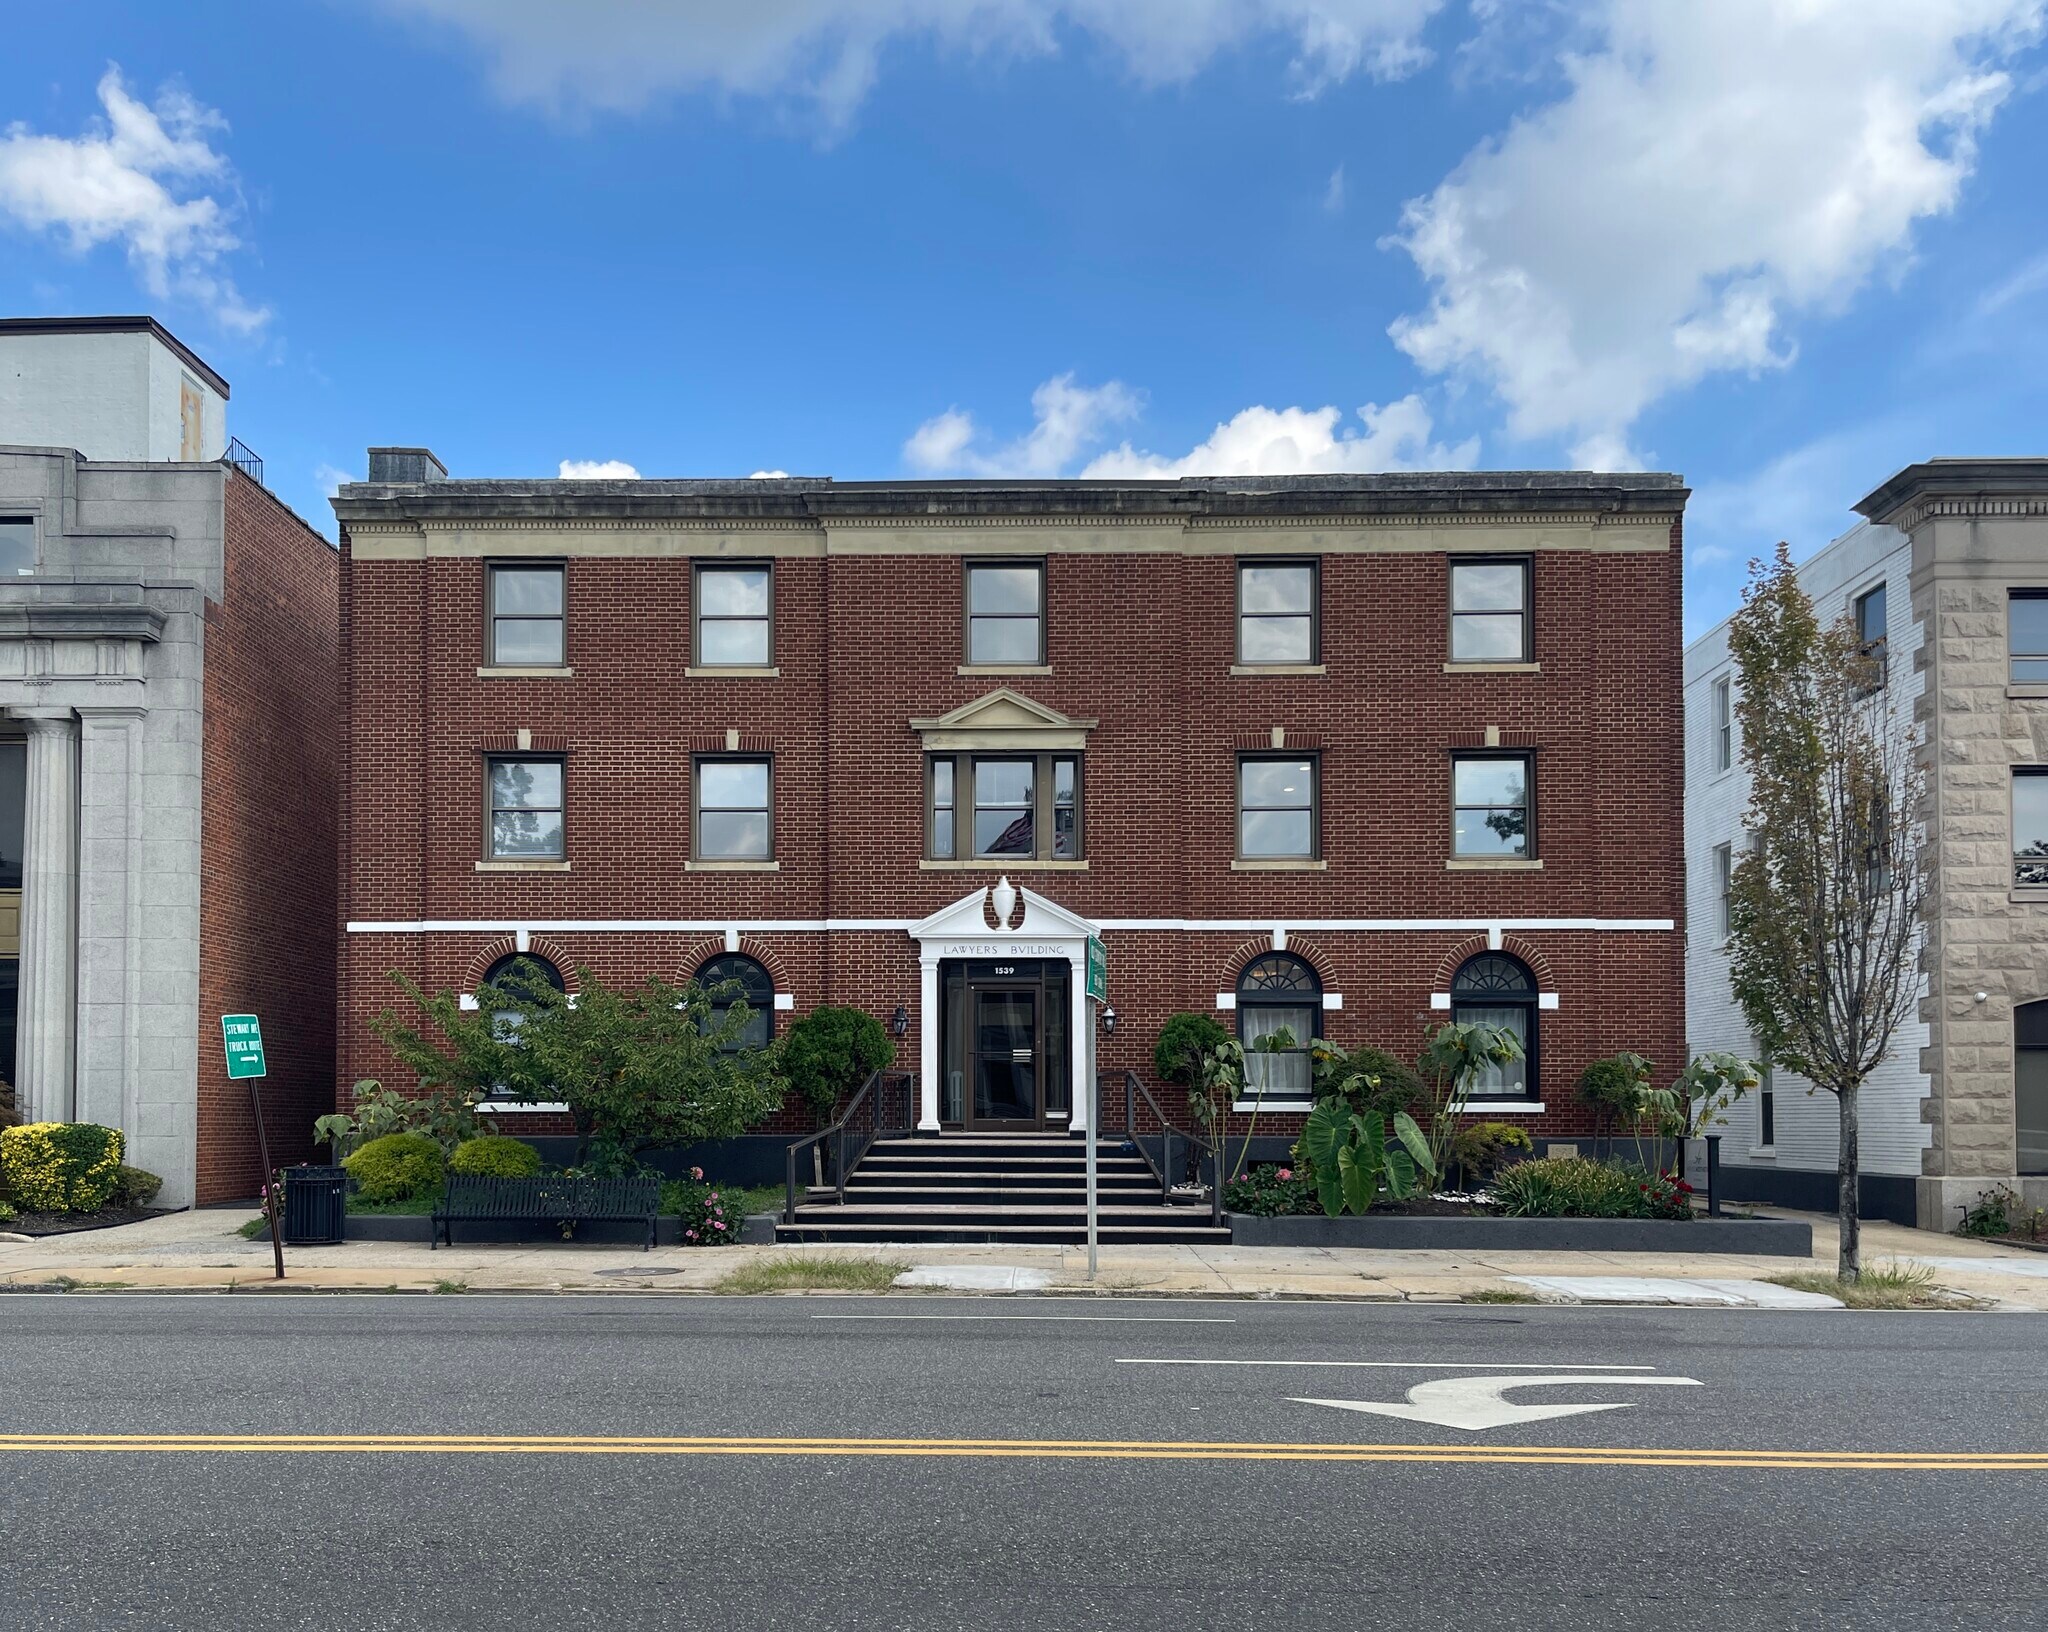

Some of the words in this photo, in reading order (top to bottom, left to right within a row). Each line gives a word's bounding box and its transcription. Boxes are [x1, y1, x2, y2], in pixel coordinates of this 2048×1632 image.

[944, 945, 998, 955] LAWYERS
[994, 967, 1015, 975] 1539
[226, 1023, 249, 1035] STEWART
[228, 1040, 248, 1053] TRUCK
